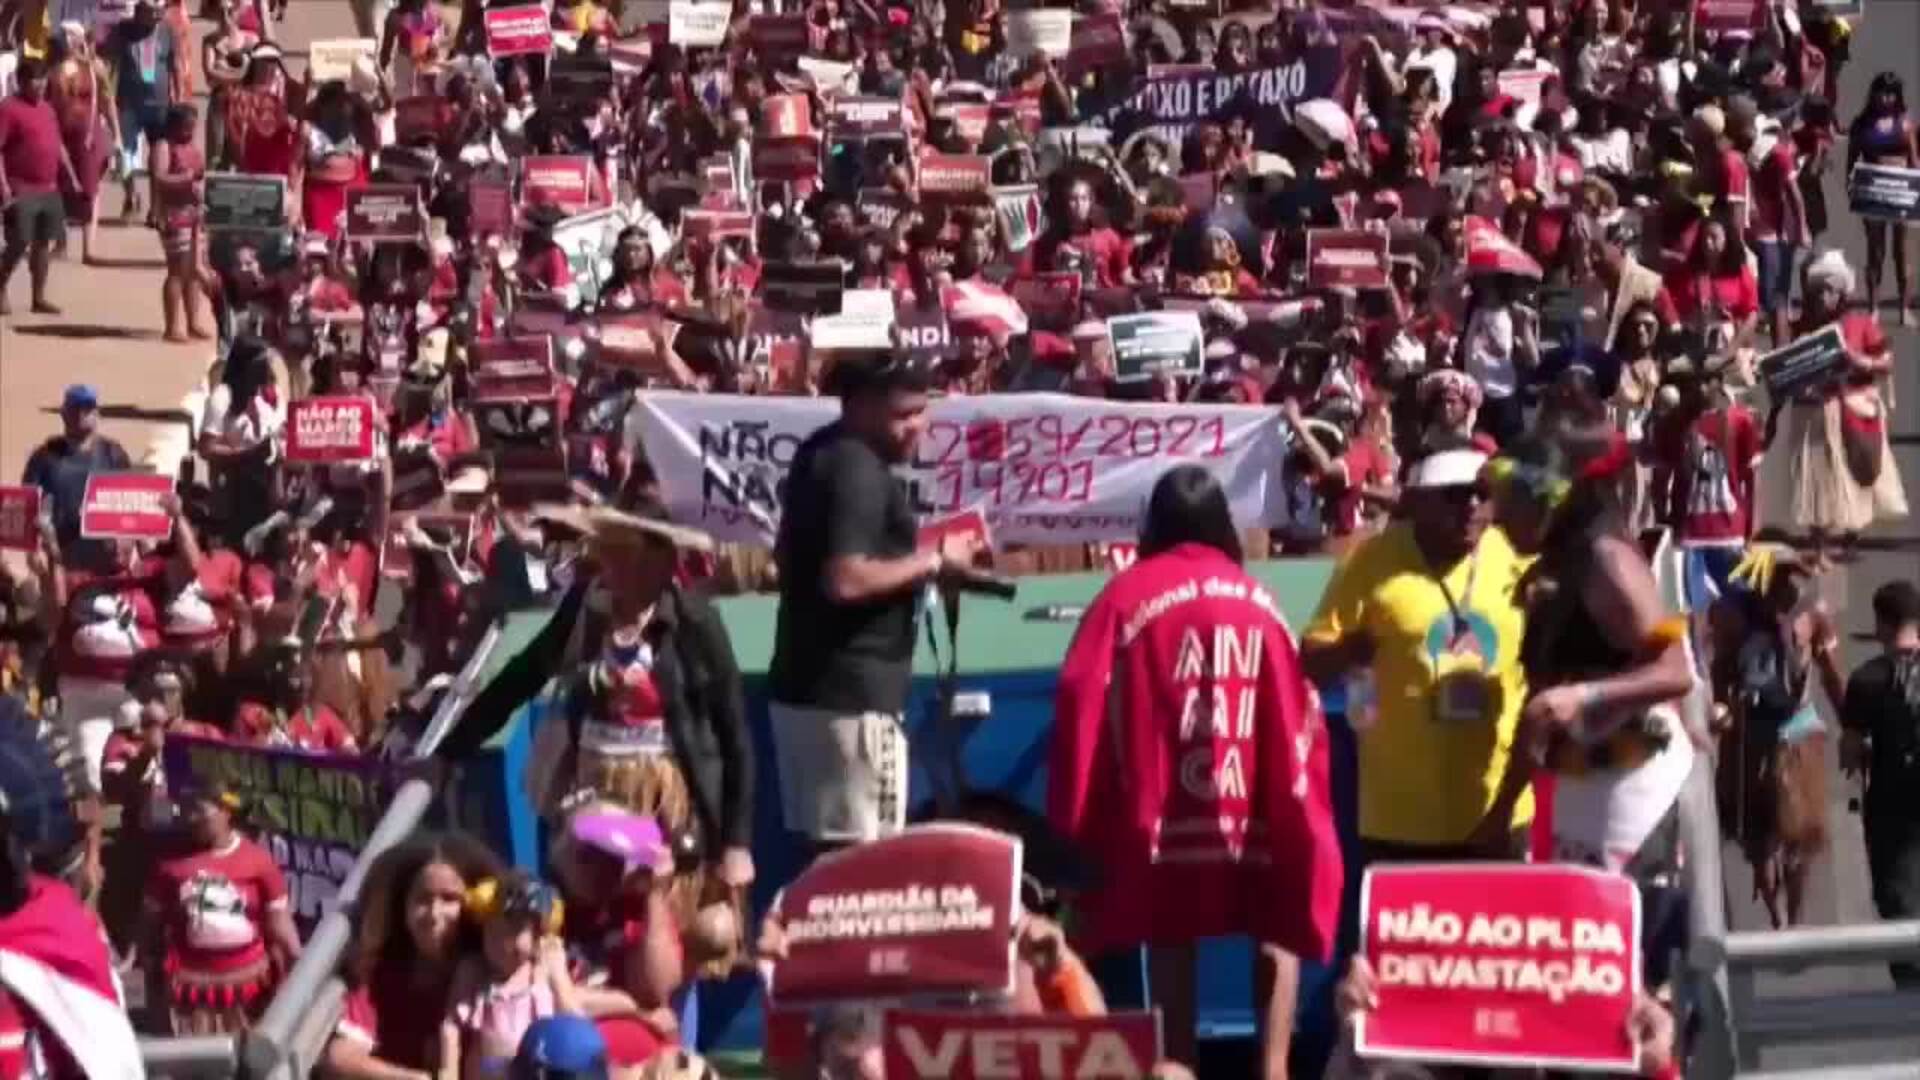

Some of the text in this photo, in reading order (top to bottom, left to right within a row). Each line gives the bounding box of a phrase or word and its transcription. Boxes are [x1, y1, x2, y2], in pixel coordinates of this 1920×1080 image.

[1196, 81, 1210, 116] E
[700, 420, 801, 468] NÃO
[927, 414, 1227, 466] 259/2021
[702, 464, 780, 513] NÃ
[787, 905, 995, 942] BIODIVERSIDADE
[807, 883, 979, 916] GUARDIÃS DA
[1377, 902, 1627, 955] NÃO AO PL DA
[1378, 953, 1626, 1005] DEVASTAÇÃO
[895, 1026, 1141, 1080] VETA
